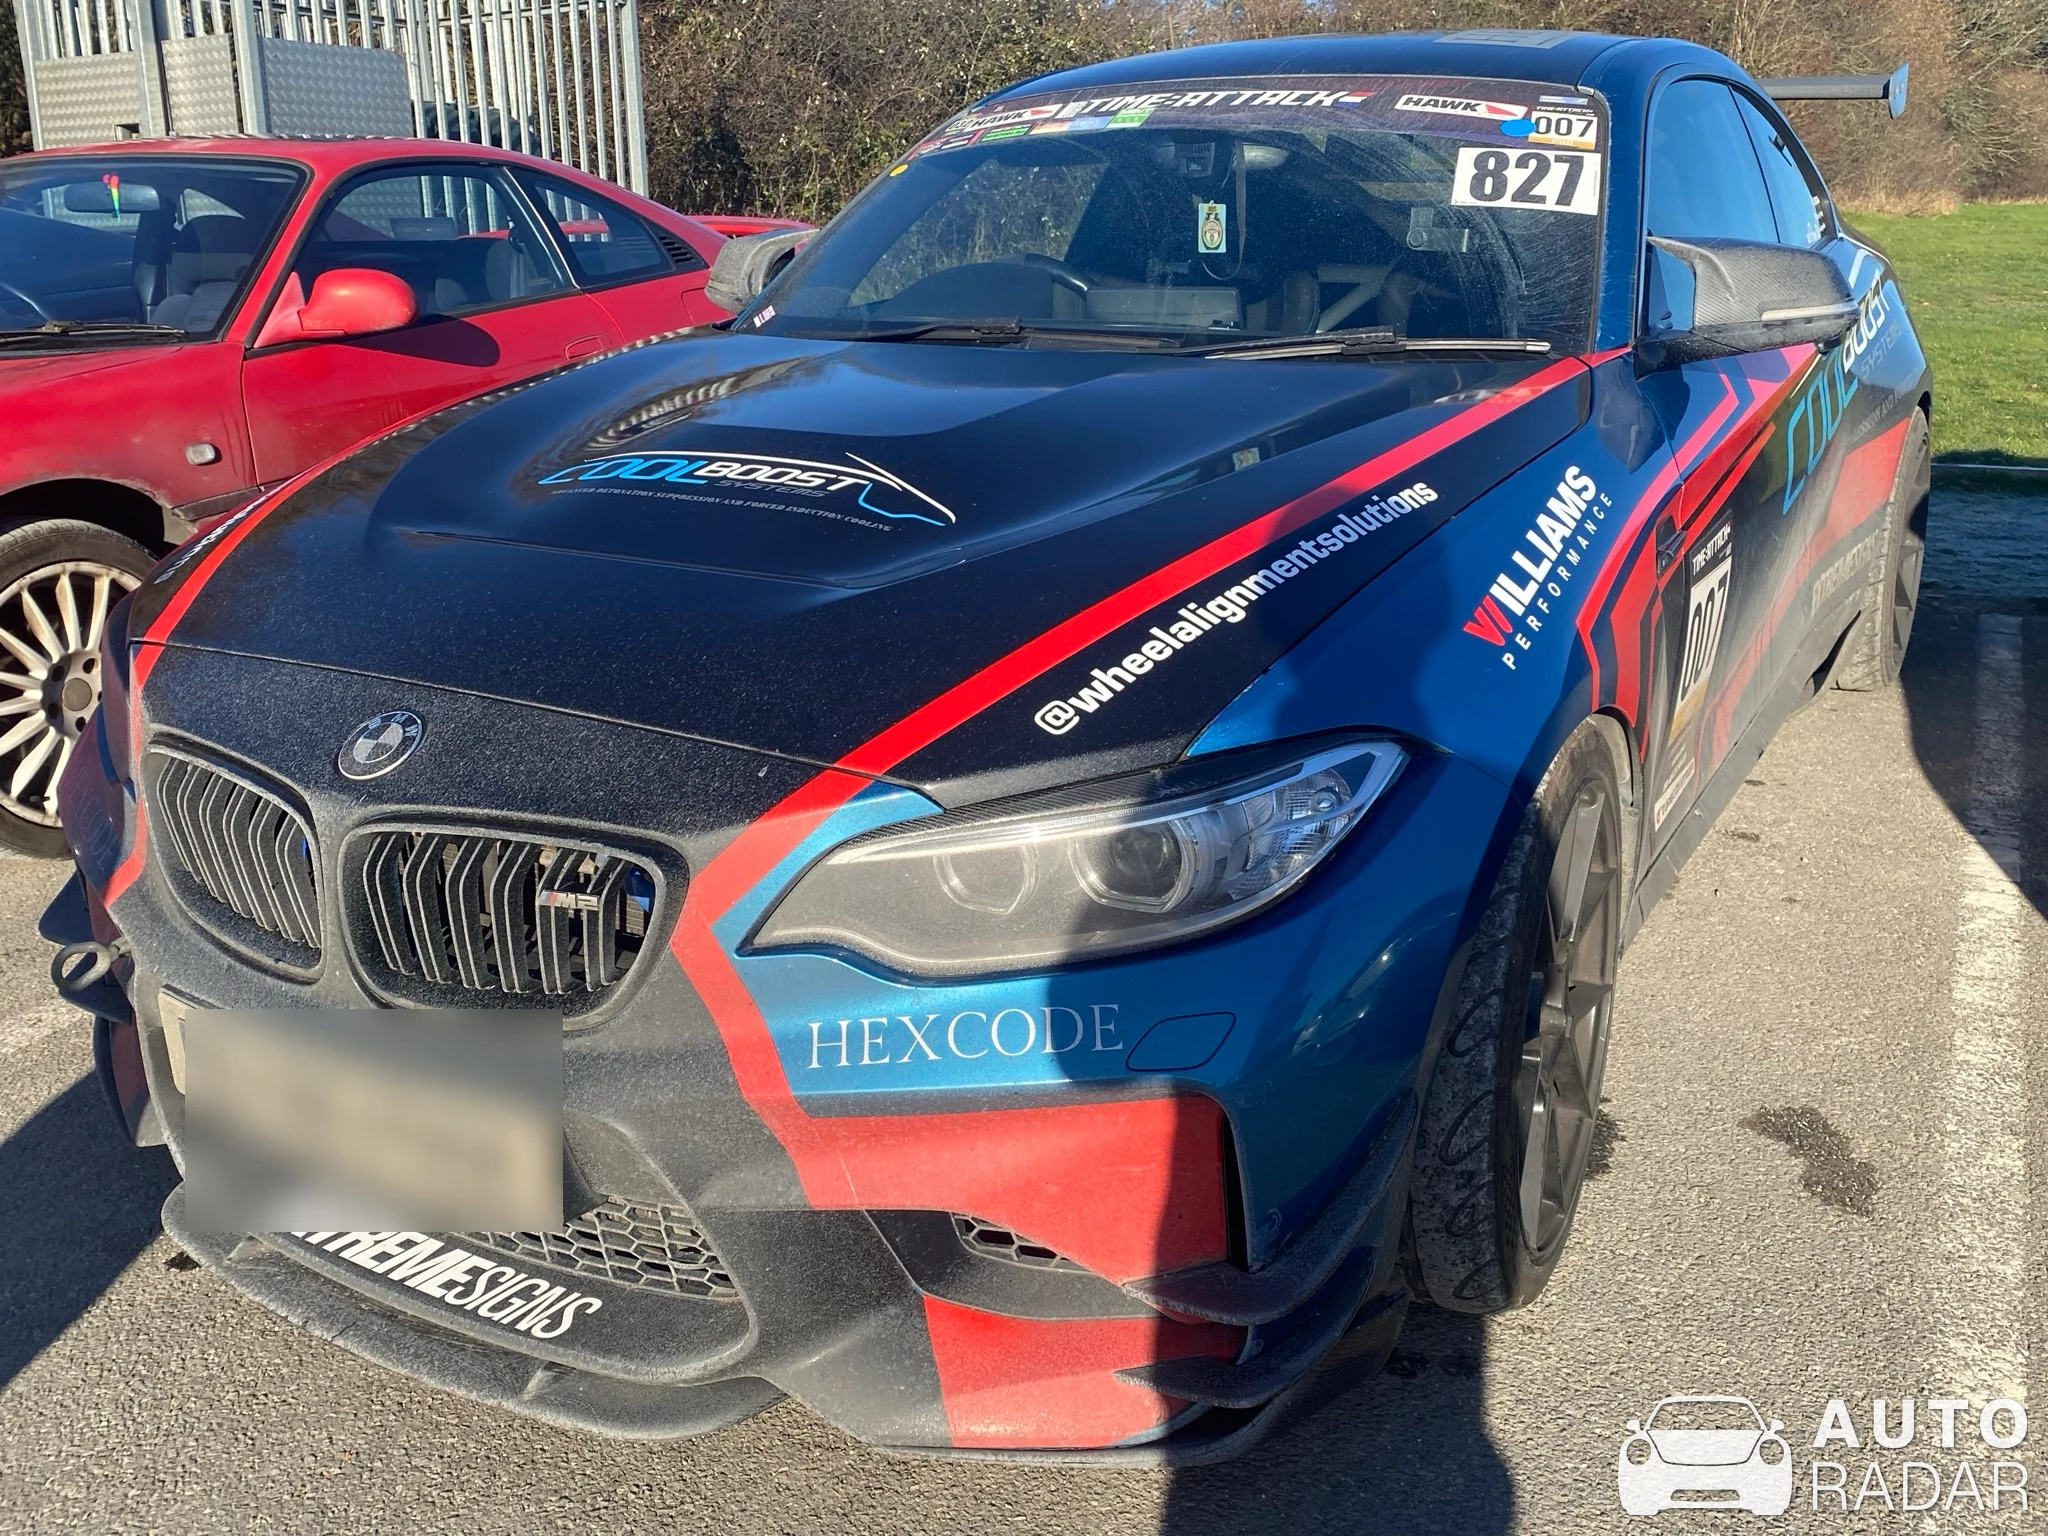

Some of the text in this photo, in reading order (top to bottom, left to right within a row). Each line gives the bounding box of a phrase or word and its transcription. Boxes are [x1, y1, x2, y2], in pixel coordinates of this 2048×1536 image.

[970, 110, 1028, 129] HAWK
[1402, 97, 1483, 112] HAWK
[1535, 116, 1594, 138] 007
[1469, 150, 1585, 206] 827
[552, 487, 892, 531] ADVANCED DETONATION SUPPRESSION AND FORCED INDUCTION COOLING
[714, 480, 831, 498] SYSTEMS
[1463, 465, 1597, 646] WILLIAMS
[1502, 493, 1613, 670] PERFORMANCE
[1034, 481, 1439, 736] @wheelalignmentsolutions
[1681, 569, 1729, 702] 007
[555, 891, 599, 911] M2
[807, 1004, 1124, 1069] HEXCODE
